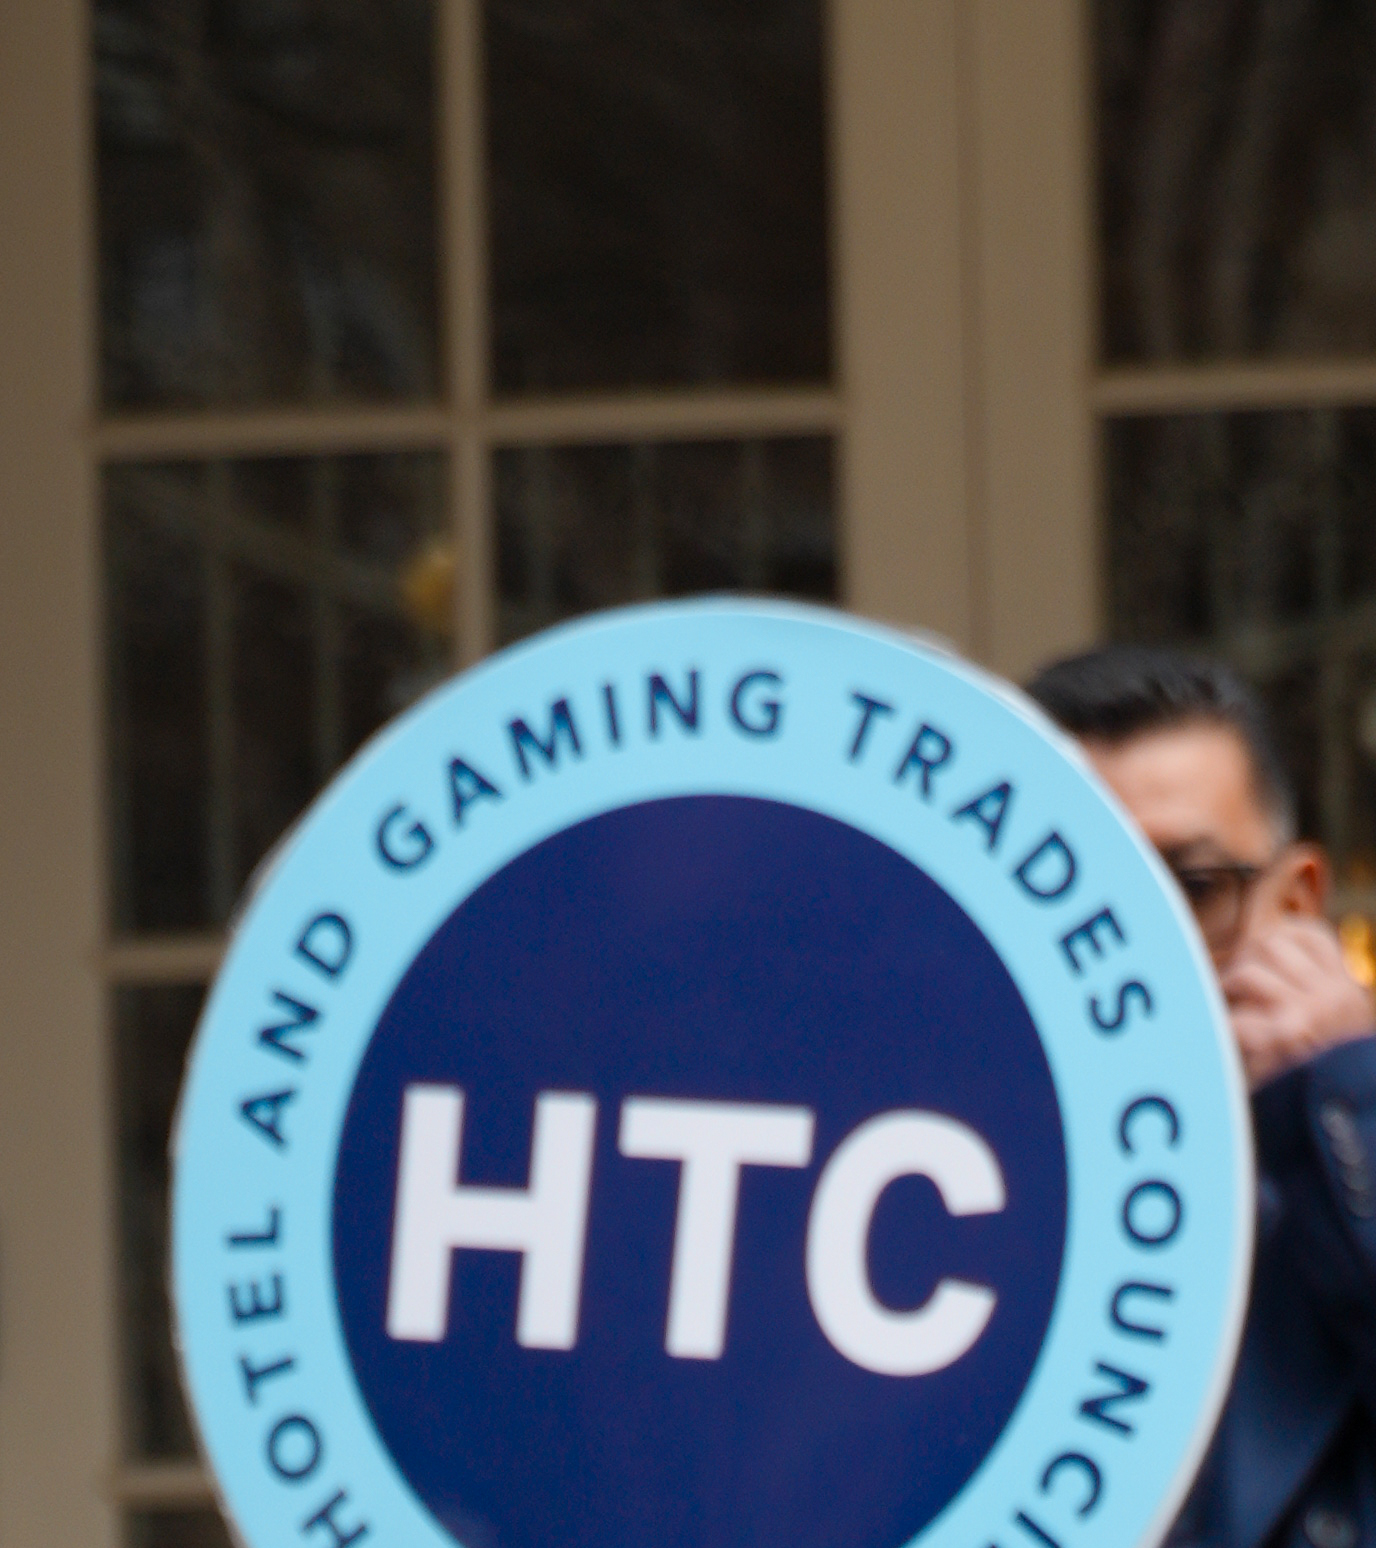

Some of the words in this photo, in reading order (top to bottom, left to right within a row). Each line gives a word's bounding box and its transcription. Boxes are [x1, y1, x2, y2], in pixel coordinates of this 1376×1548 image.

[236, 910, 360, 1151] AND
[375, 669, 784, 877] GAMING
[843, 689, 1155, 1036] TRADES
[386, 1085, 1006, 1378] HTC
